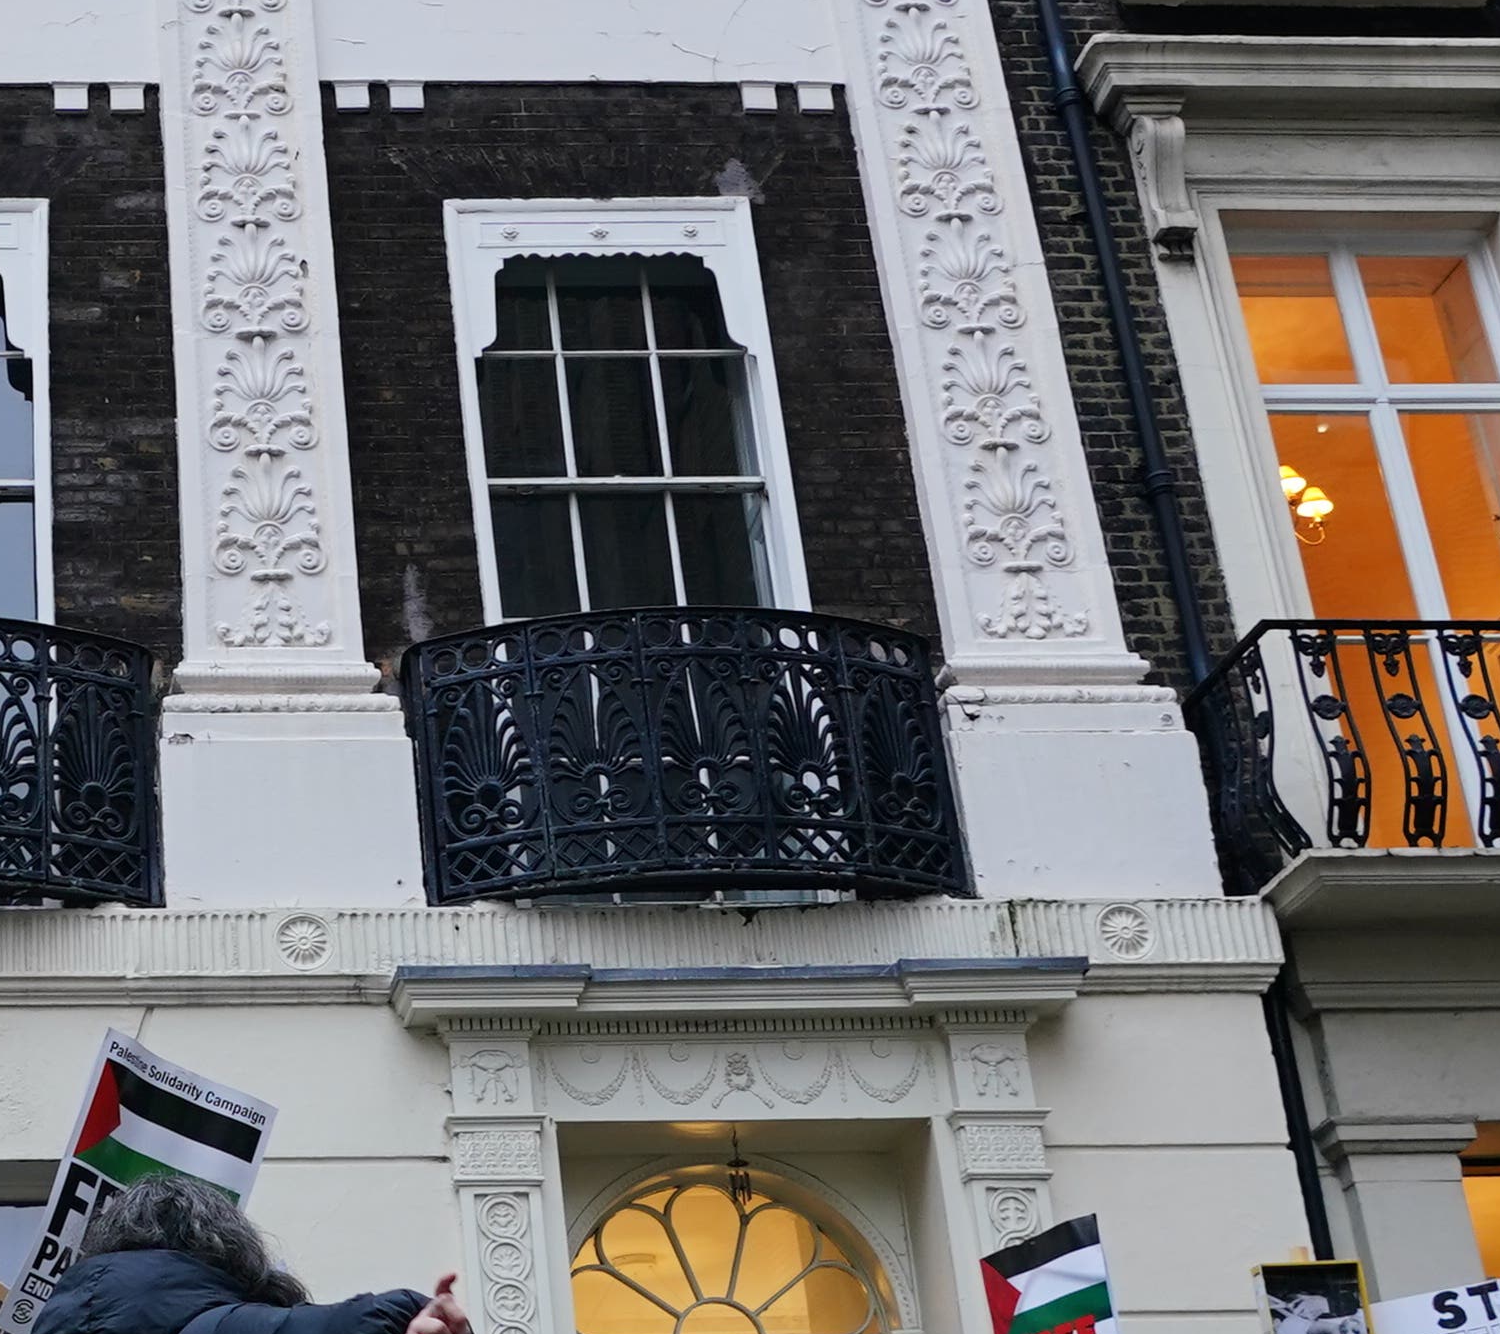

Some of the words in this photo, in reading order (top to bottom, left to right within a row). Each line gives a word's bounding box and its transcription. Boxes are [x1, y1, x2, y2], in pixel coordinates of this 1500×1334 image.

[109, 1041, 149, 1073] Palestine
[148, 1066, 202, 1102] Solidarity
[205, 1091, 266, 1126] Campaign
[23, 1275, 54, 1300] END
